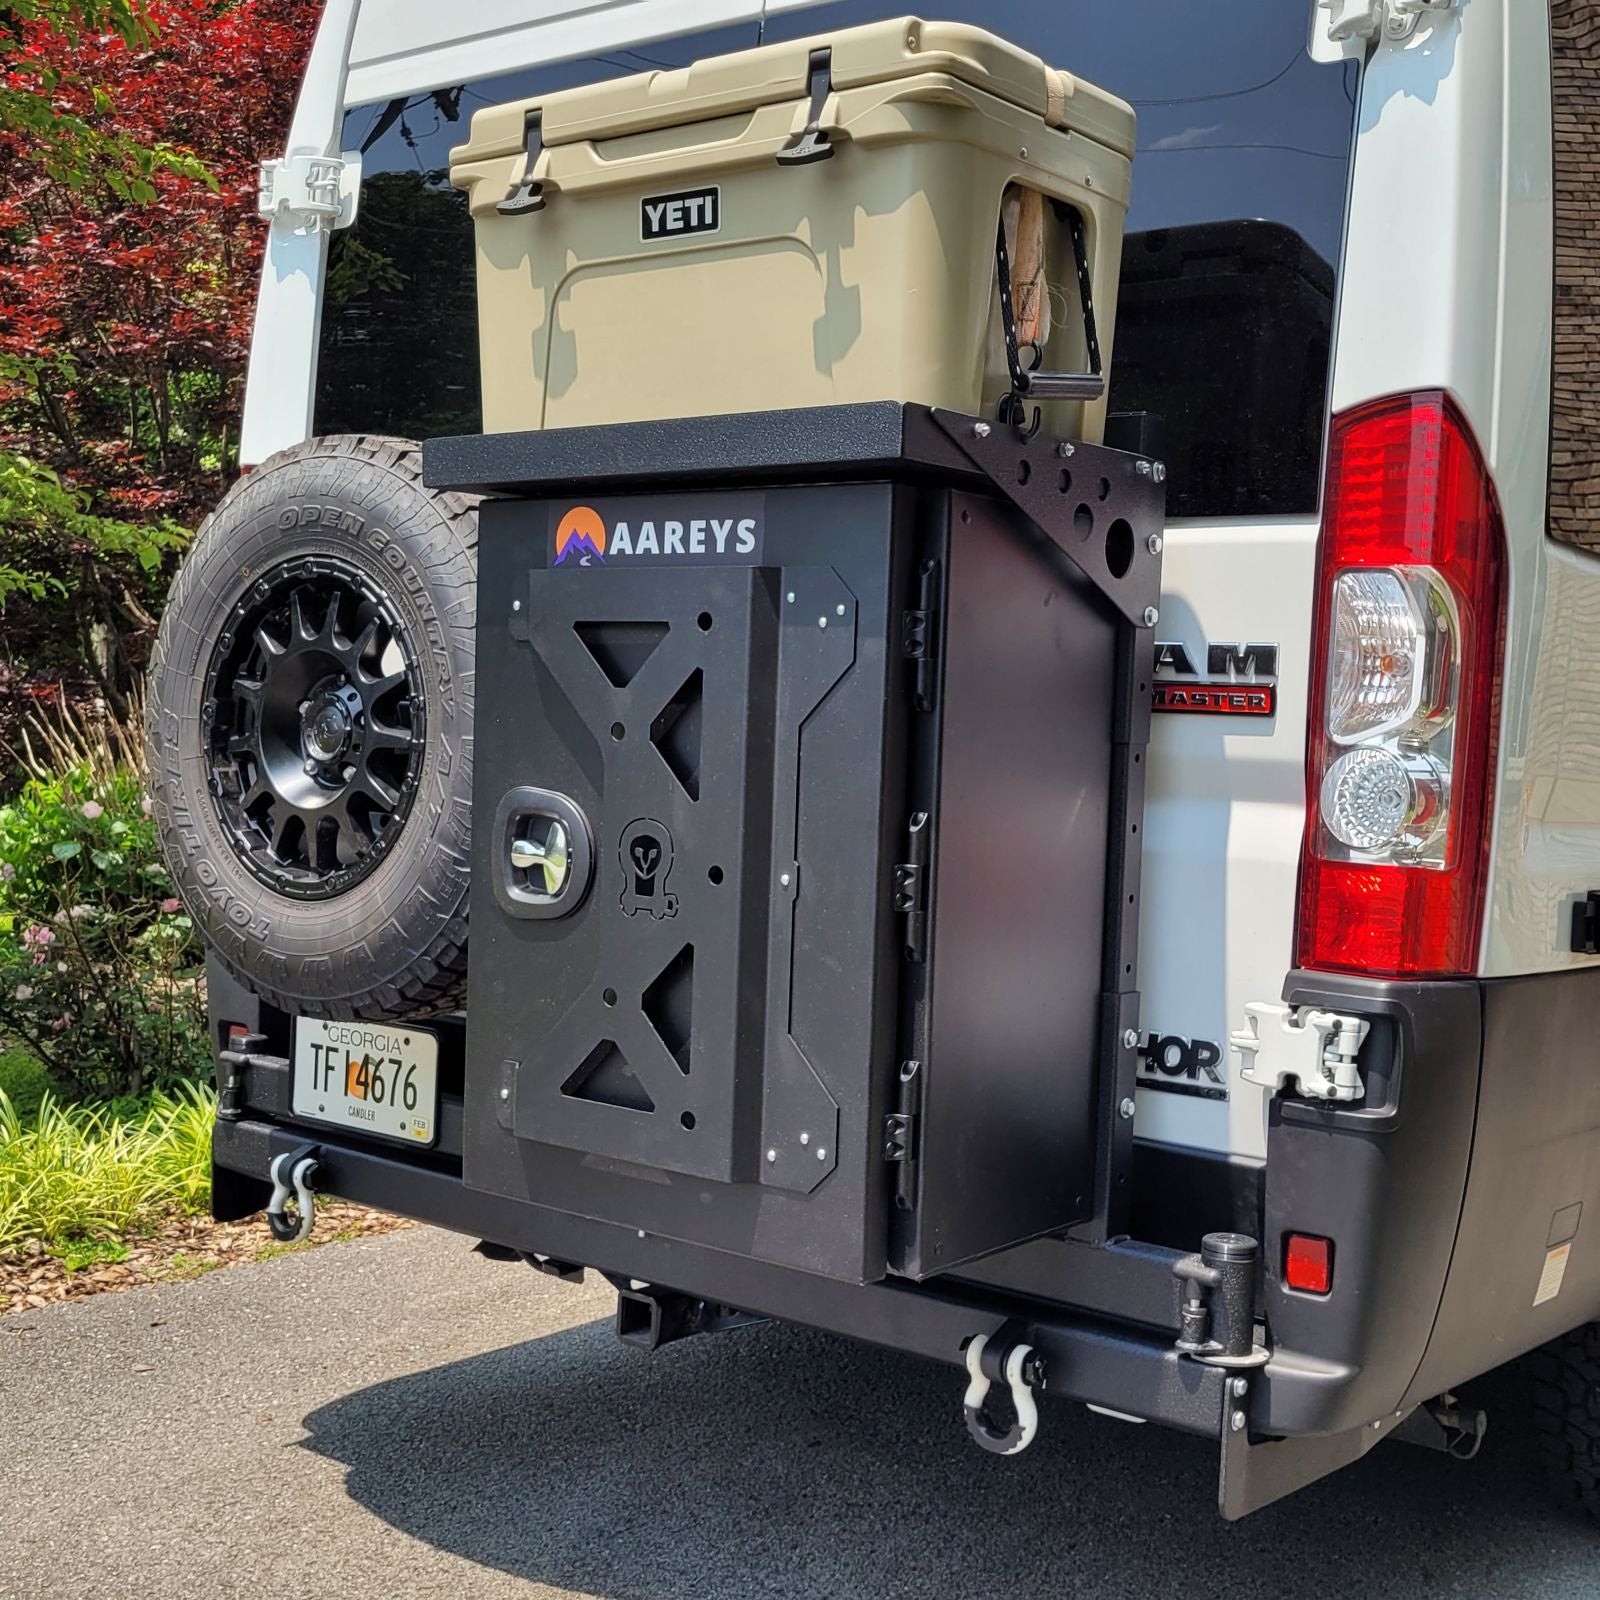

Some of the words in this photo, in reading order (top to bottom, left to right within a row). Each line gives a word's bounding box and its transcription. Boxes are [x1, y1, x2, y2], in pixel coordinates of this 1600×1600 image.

[644, 195, 713, 232] YETI
[608, 519, 757, 555] AAREYS
[278, 504, 366, 536] OPEN
[367, 528, 455, 720] COUNTRY
[1154, 641, 1279, 677] AM
[1152, 687, 1266, 708] MASTER
[163, 708, 201, 857] TIRES
[196, 859, 272, 941] TOYO
[328, 1025, 402, 1055] GEORGIA
[1137, 1031, 1226, 1084] HOR
[348, 1105, 376, 1121] CANDLER
[413, 1119, 426, 1129] FEB
